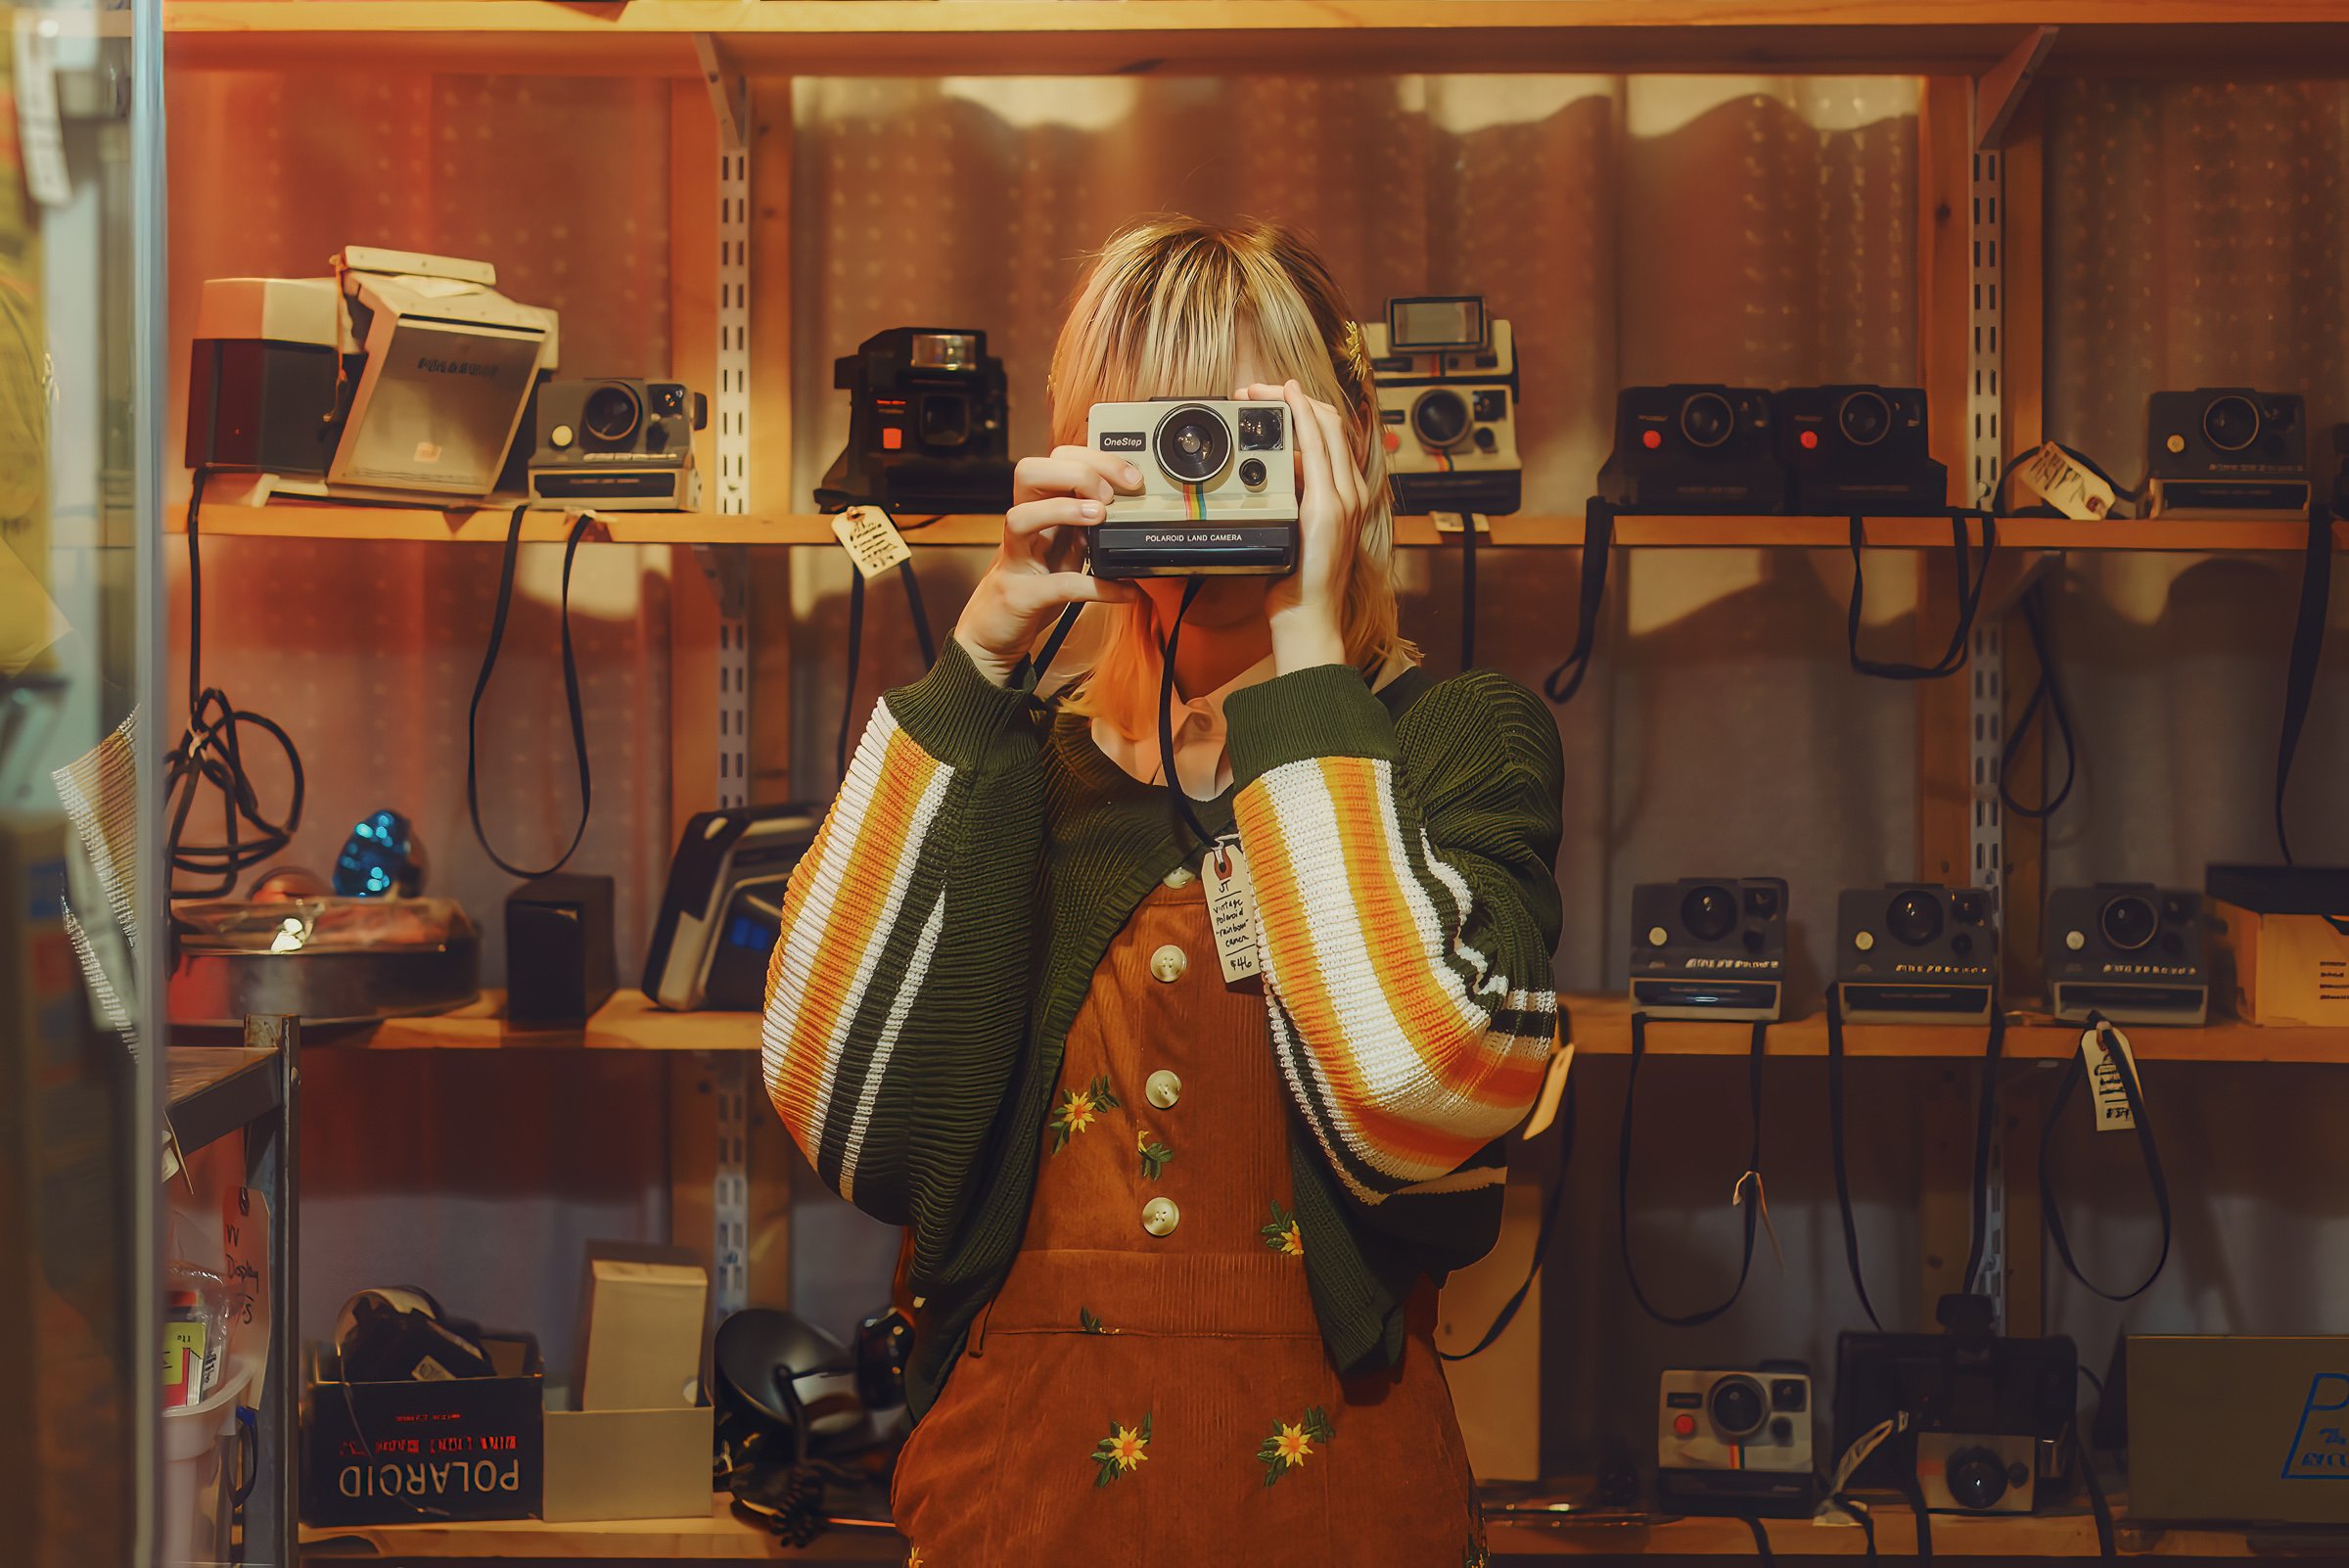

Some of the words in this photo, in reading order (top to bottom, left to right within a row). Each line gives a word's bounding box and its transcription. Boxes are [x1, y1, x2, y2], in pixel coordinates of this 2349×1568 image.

[1104, 438, 1142, 447] OneStep
[1230, 955, 1252, 971] $46
[339, 1458, 519, 1498] POLAROID
